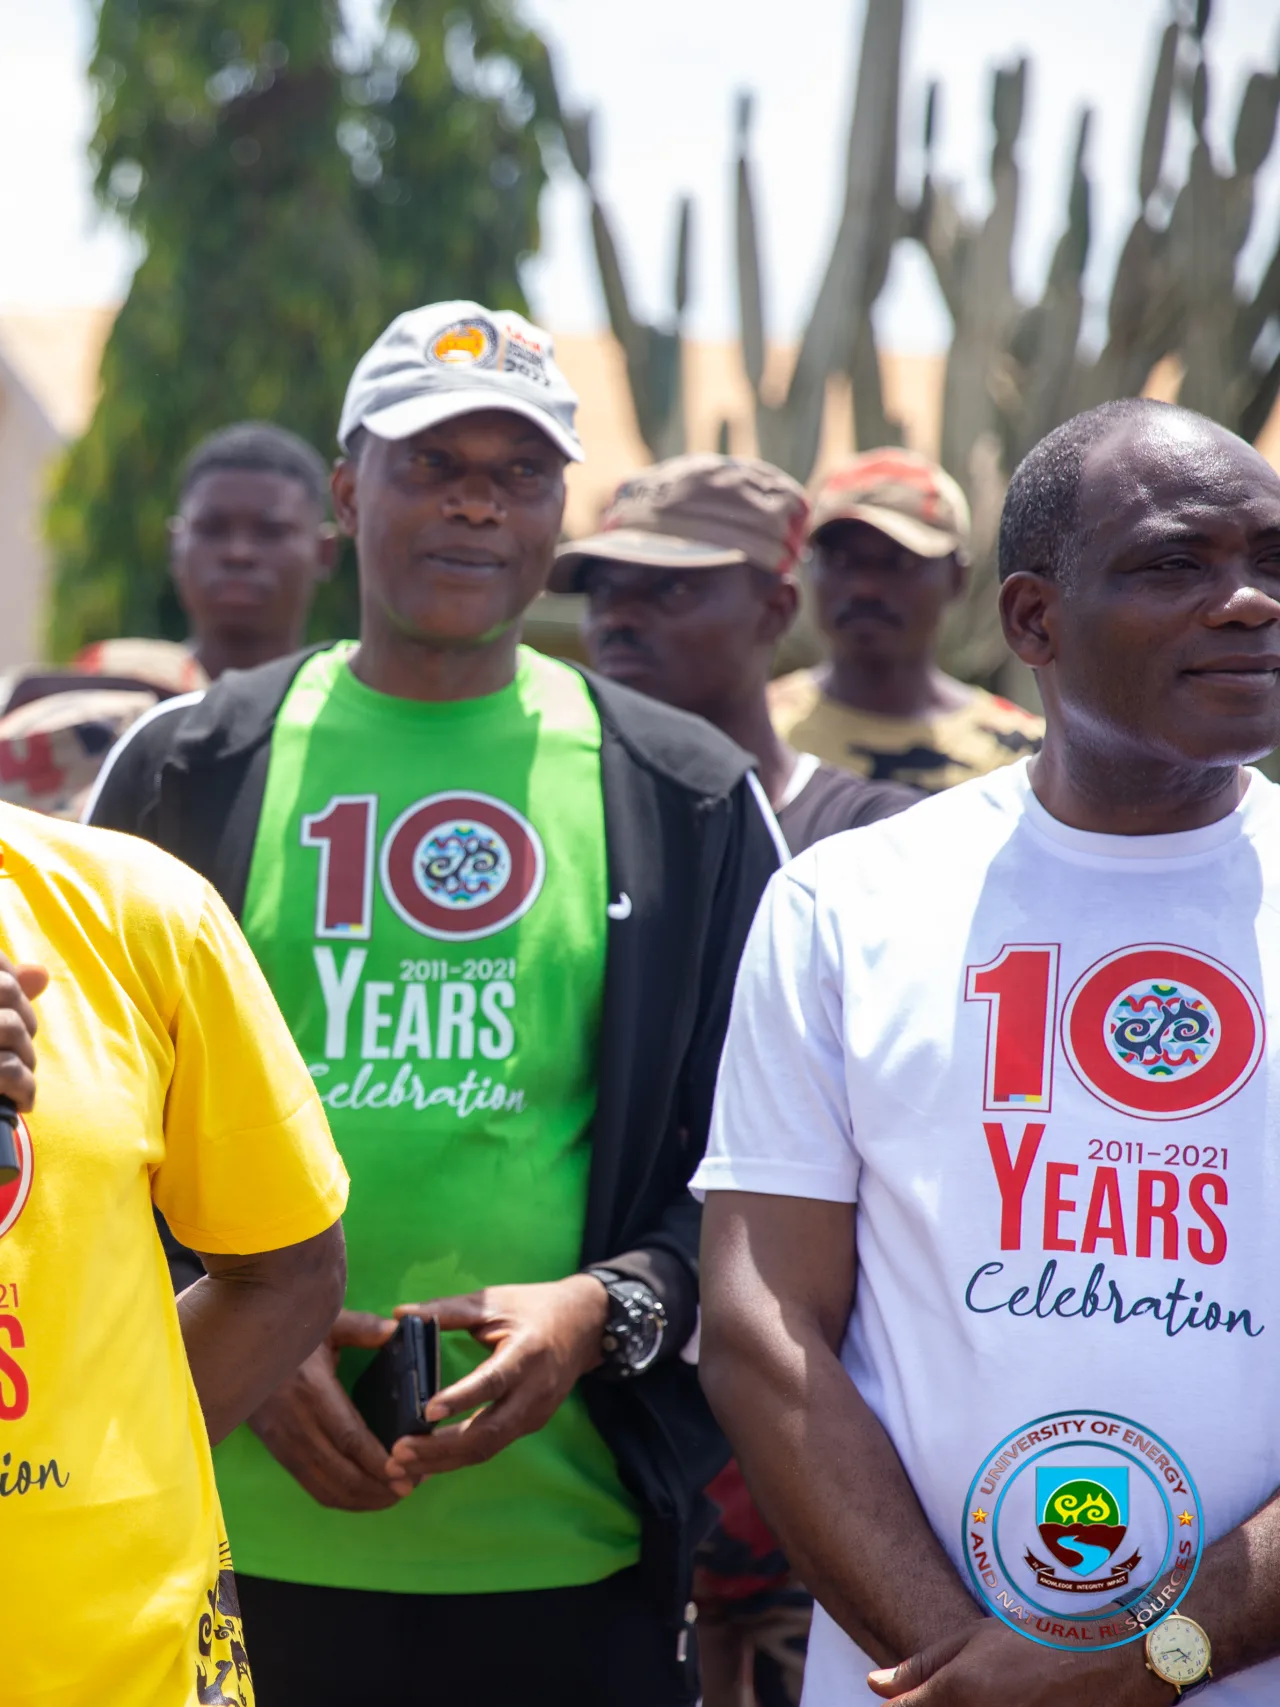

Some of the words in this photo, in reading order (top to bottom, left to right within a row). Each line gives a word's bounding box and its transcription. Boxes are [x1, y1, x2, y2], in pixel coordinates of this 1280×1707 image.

[300, 788, 547, 942] 10
[313, 946, 516, 1061] YEARS
[399, 958, 516, 982] 2011-2021
[964, 942, 1266, 1122] 10
[983, 1122, 1229, 1266] YEARS
[1088, 1139, 1229, 1170] 2011-2021
[965, 1259, 1265, 1338] Celebration
